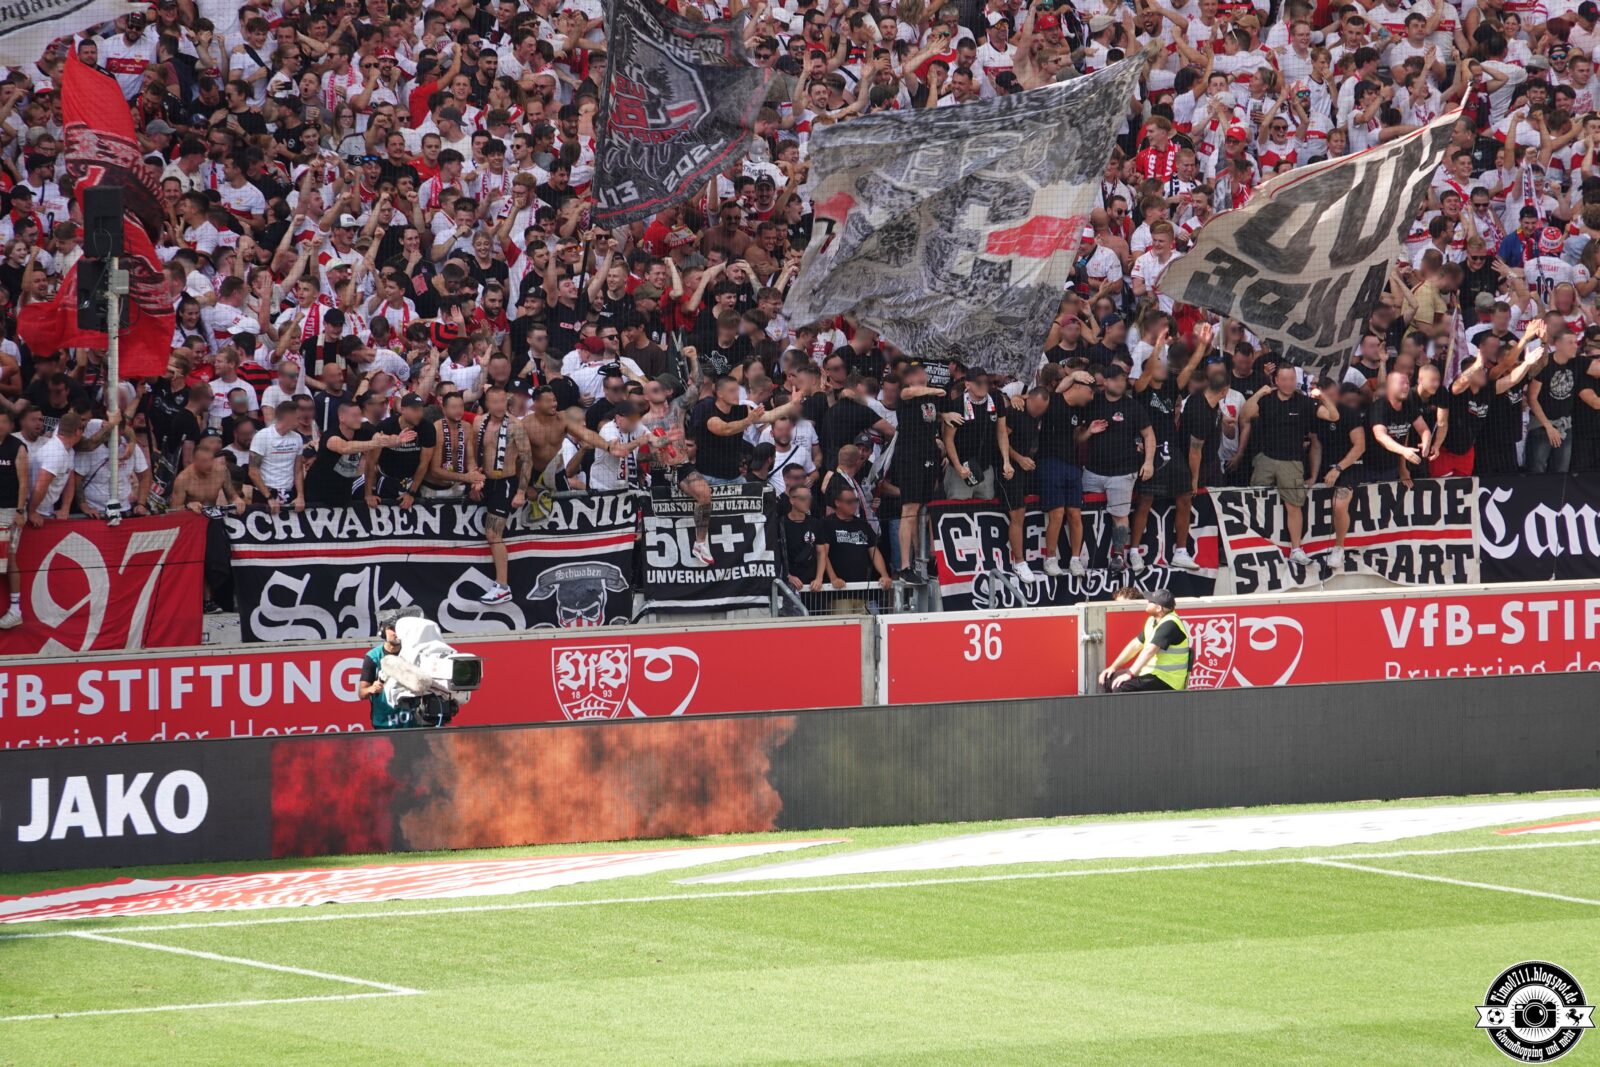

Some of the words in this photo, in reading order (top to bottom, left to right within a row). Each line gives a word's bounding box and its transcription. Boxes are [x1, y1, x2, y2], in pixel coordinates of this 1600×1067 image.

[223, 504, 445, 541] SCHWABEN
[453, 490, 637, 536] KOMANIE
[726, 500, 762, 511] ULTRAS
[555, 568, 602, 580] Schwaben
[647, 564, 776, 584] UNVERHANDELBAR
[963, 622, 1002, 662] 36
[571, 691, 581, 699] 18
[603, 690, 613, 698] 93
[18, 769, 209, 842] JAKO
